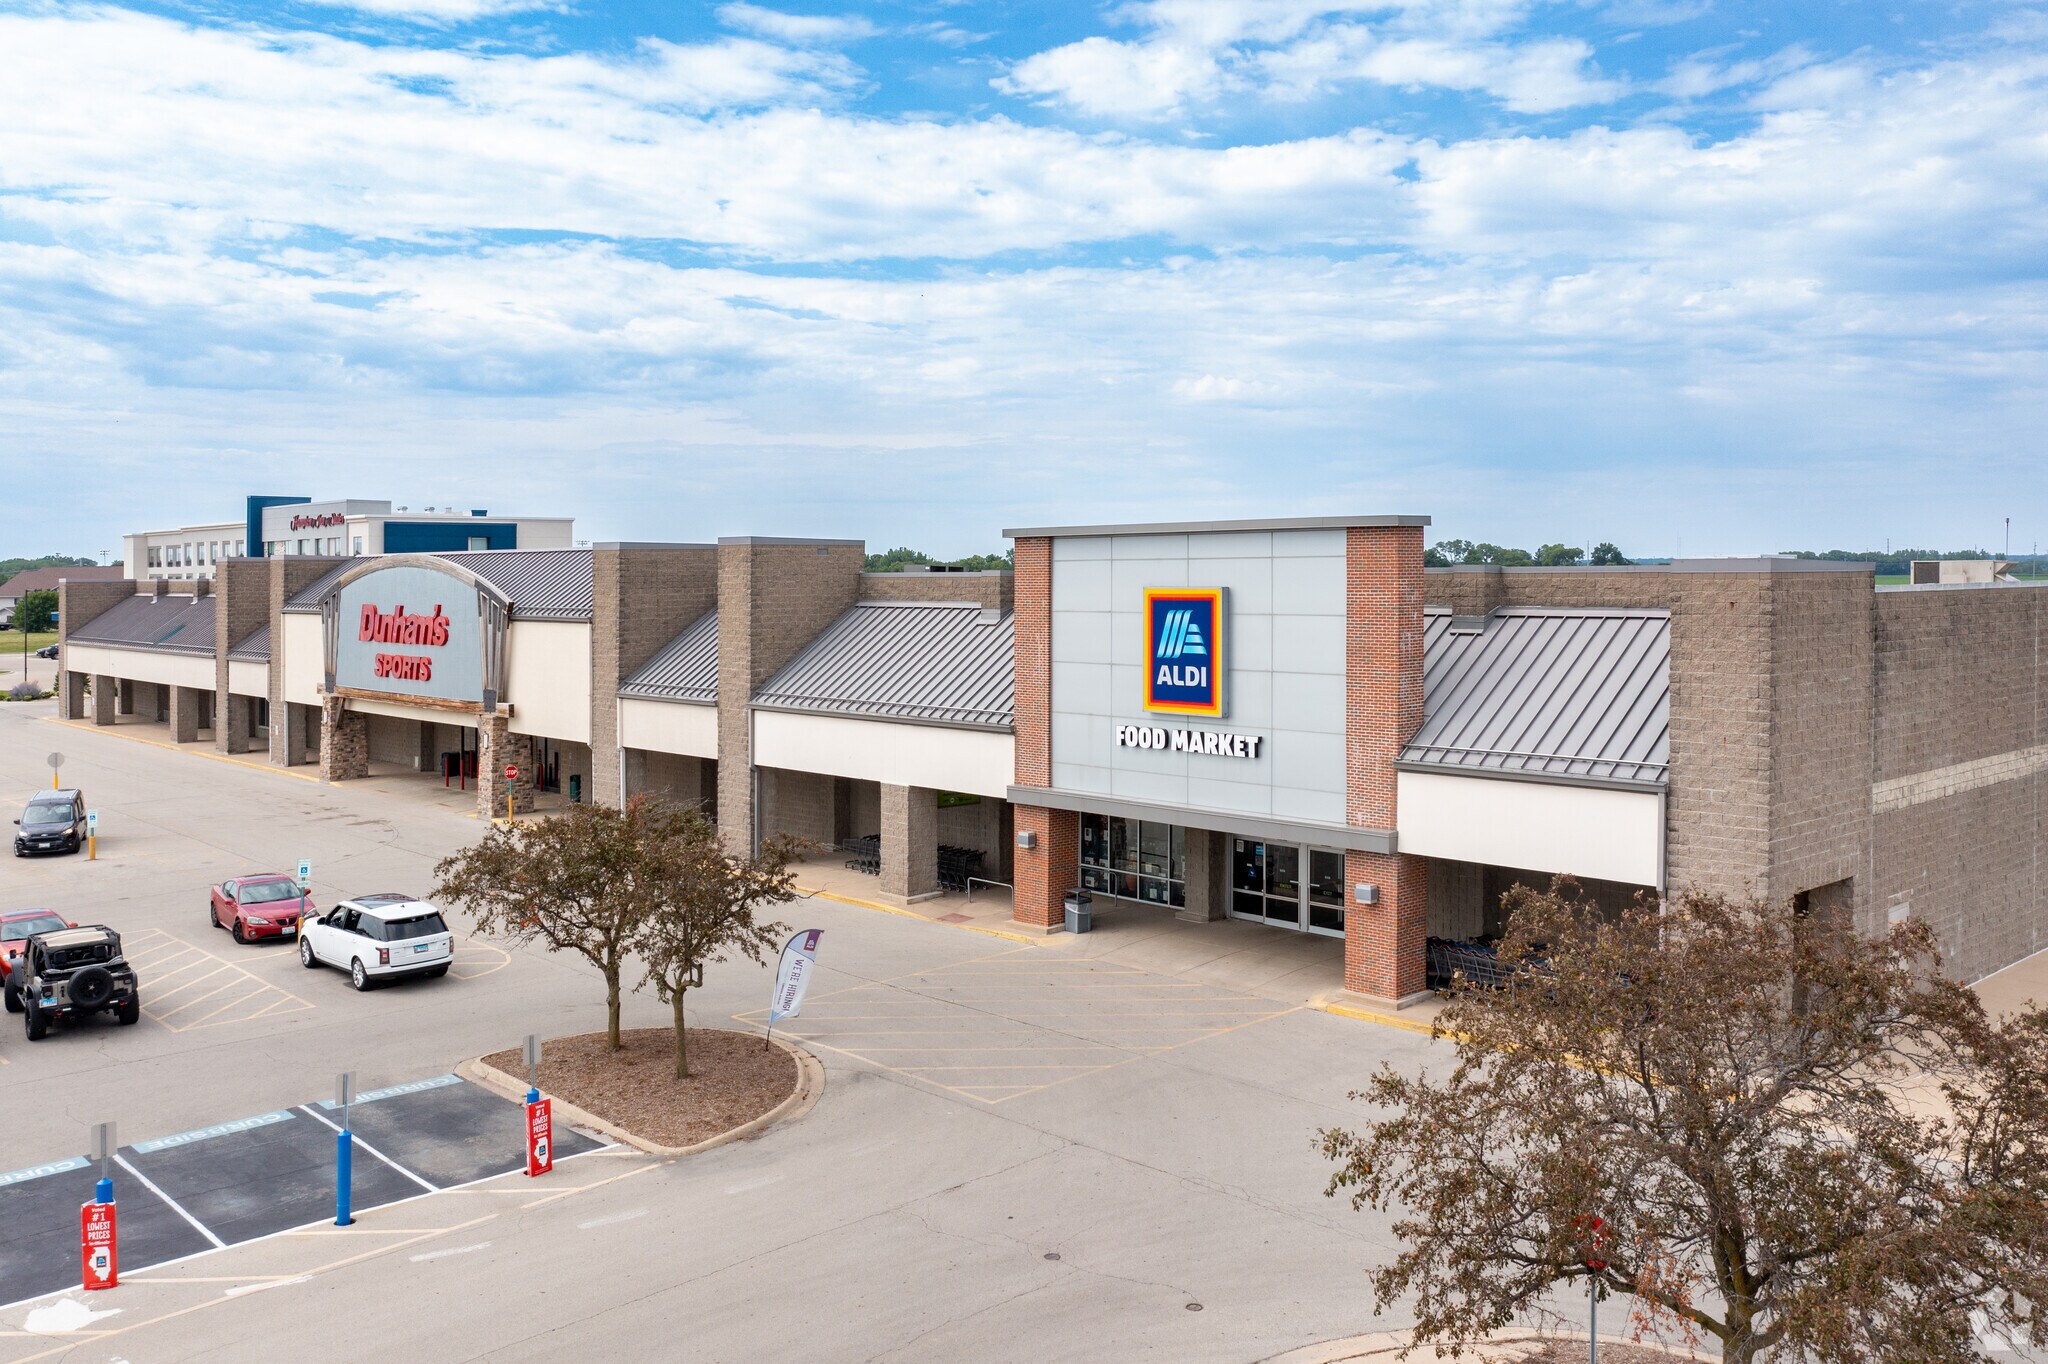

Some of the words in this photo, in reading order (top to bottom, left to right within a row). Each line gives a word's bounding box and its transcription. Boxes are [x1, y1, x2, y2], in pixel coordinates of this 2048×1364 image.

[359, 604, 449, 646] Dunham's
[374, 653, 432, 681] SPORTS
[1156, 665, 1207, 687] ALDI
[1116, 725, 1168, 749] FOOD
[1171, 729, 1262, 759] MARKET
[145, 1113, 282, 1150] CURBSIDE
[87, 1221, 110, 1231] LOWEST
[87, 1231, 110, 1240] PRICES
